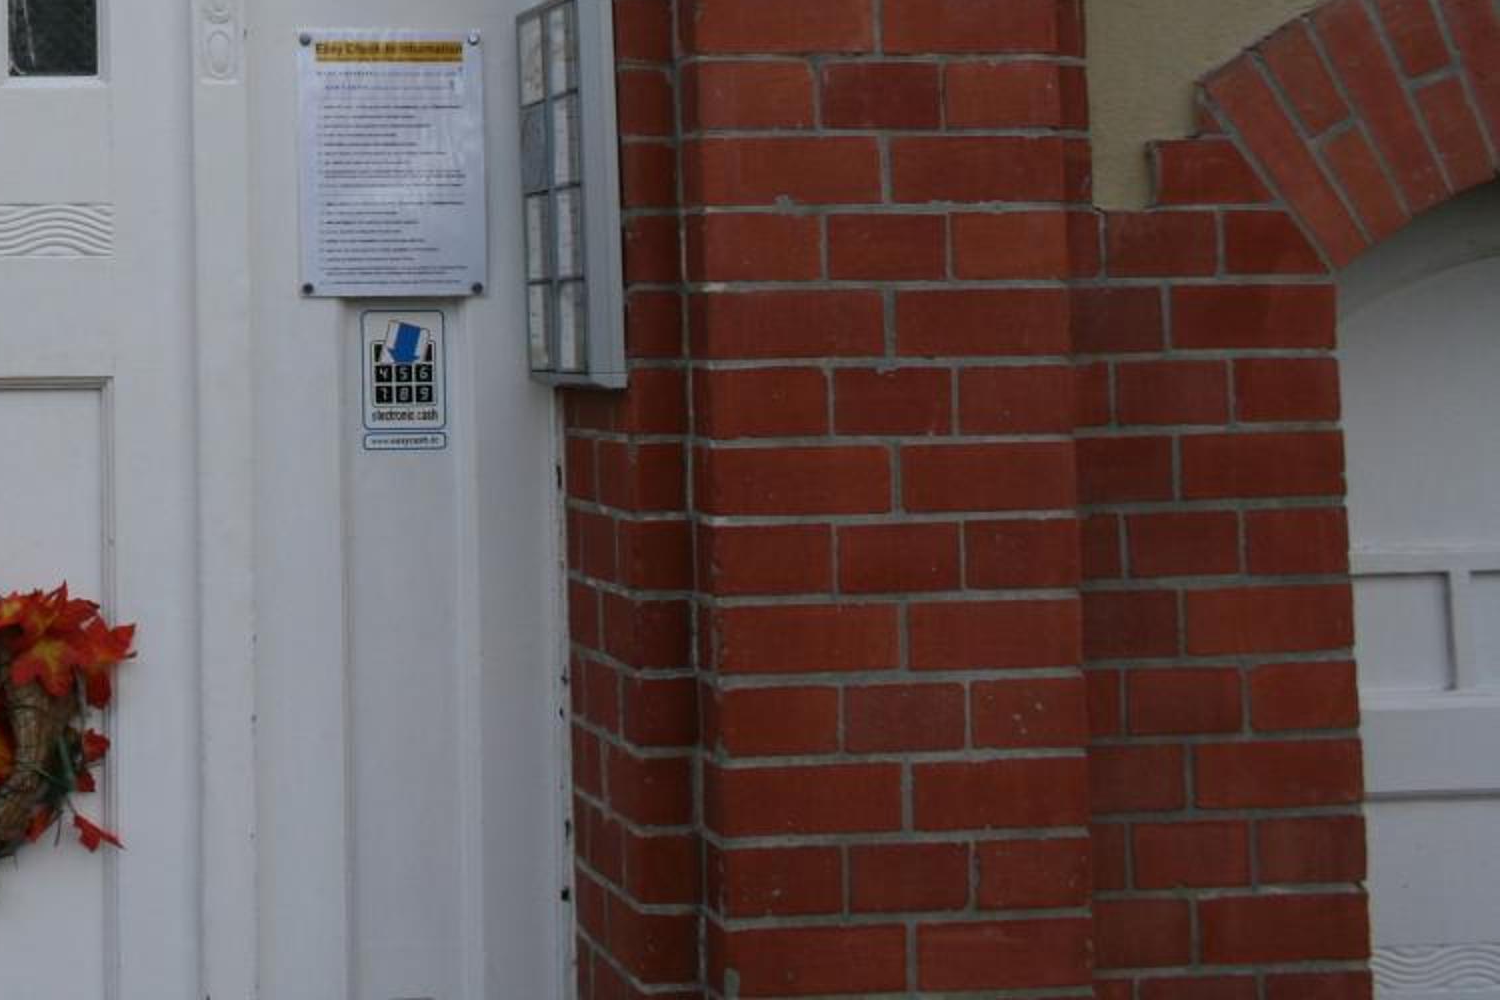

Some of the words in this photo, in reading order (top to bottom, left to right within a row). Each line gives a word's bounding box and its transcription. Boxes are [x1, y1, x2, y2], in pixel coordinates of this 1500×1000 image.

[379, 367, 389, 380] 4
[399, 367, 409, 380] 5
[419, 366, 429, 379] 6
[379, 387, 389, 400] 7
[399, 387, 409, 401] 8
[419, 387, 430, 401] 9
[372, 409, 414, 421] electronic
[417, 408, 438, 421] cash
